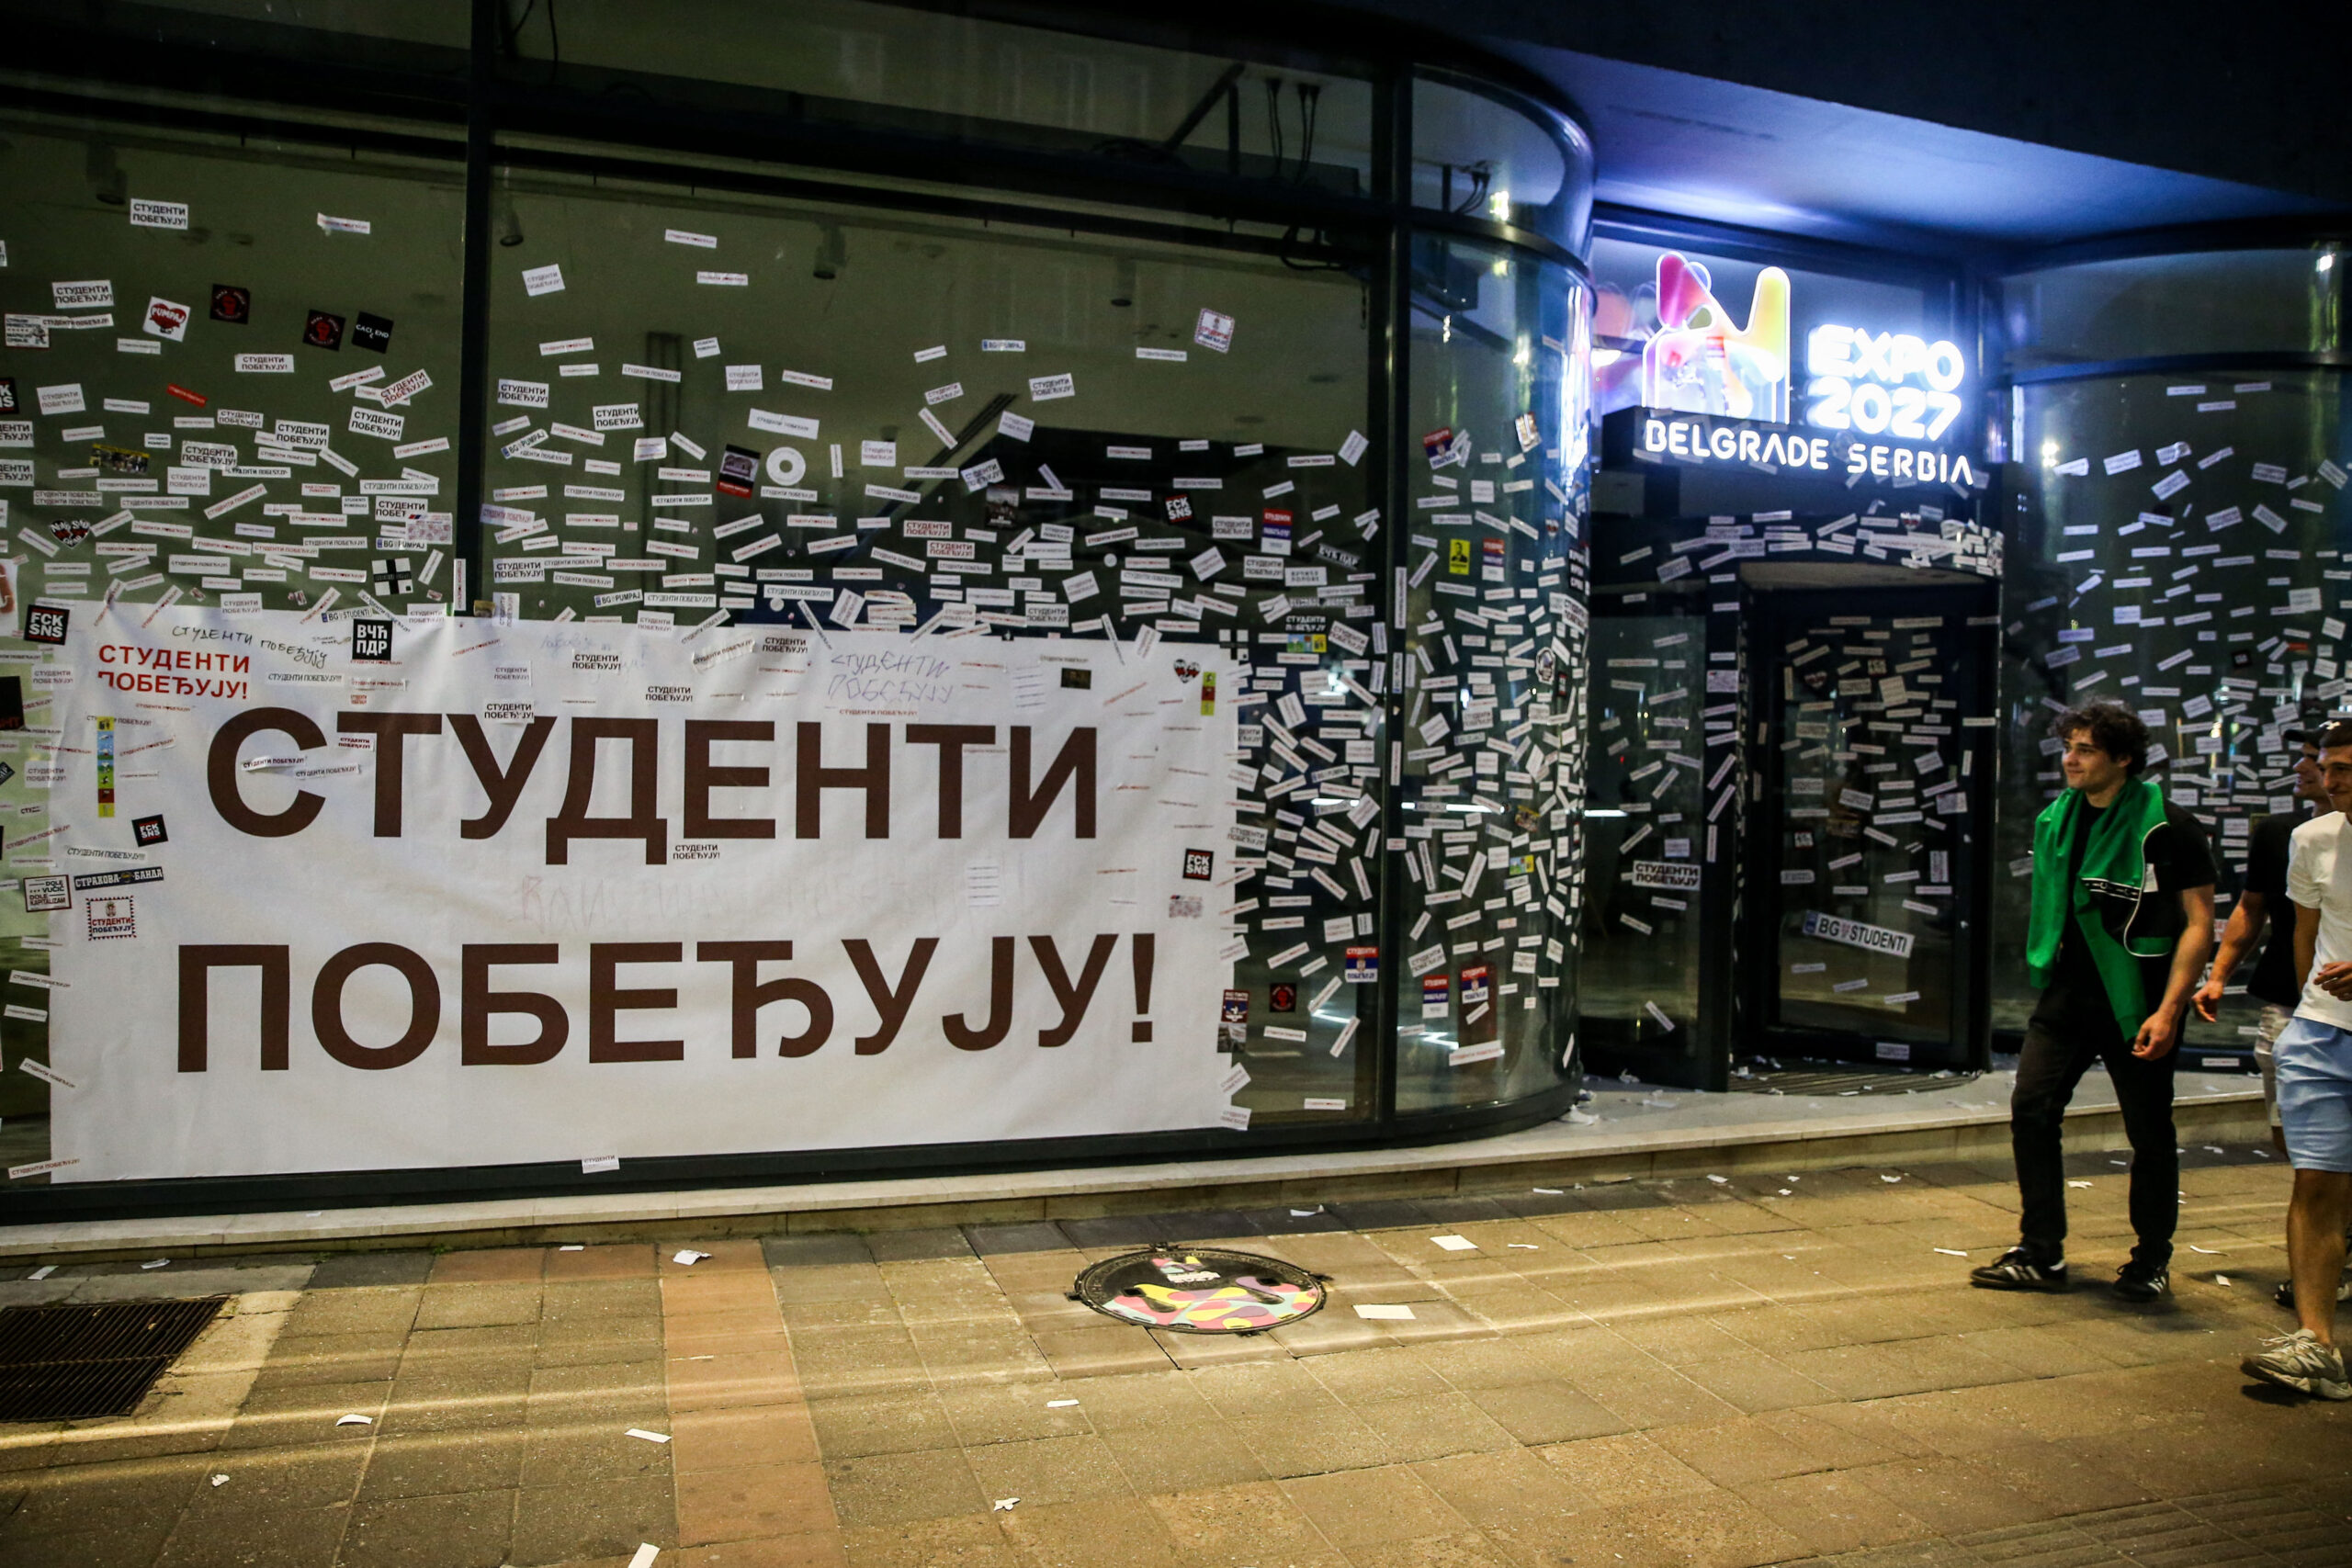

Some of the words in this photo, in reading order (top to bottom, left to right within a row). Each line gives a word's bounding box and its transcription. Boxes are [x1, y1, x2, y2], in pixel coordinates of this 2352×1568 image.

[134, 203, 186, 215] СТУДЕНТИ
[132, 214, 187, 224] ПОБЕЂУЈУ!
[56, 286, 108, 295] СТУДЕНТИ
[55, 294, 112, 303] ПОБЕЂУЈУ!
[151, 307, 184, 323] PUMPAJ
[243, 355, 285, 364] СТУДЕНТИ
[1808, 324, 1964, 392] EXPO
[501, 383, 546, 395] СТУДЕНТИ
[498, 391, 548, 403] ПОБЕЂУЈУ!
[595, 408, 639, 418] СТУДЕНТИ
[1806, 376, 1962, 442] 2027
[220, 410, 260, 420] СТУДЕНТИ
[354, 411, 401, 427] СТУДЕНТИ
[596, 417, 640, 427] ПОБЕЂУЈУ
[277, 424, 327, 435] СТУДЕНТИ
[351, 420, 401, 438] ПОБЕЂУЈУ!
[277, 434, 327, 446] ПОБЕЂУЈУ!
[185, 446, 234, 457] СТУДЕНТИ
[1645, 419, 1829, 470] BELGRADE
[1847, 443, 1973, 485] SERBIA
[379, 501, 425, 511] СТУДЕНТИ
[1166, 497, 1189, 511] FCK
[1169, 507, 1193, 520] SNS
[929, 549, 973, 558] ПОБЕЂУЈУ!
[496, 561, 541, 570] СТУДЕНТИ
[494, 570, 544, 579] ПОБЕЂУЈУ!
[601, 596, 611, 604] BG
[615, 592, 640, 602] PUMPAJ
[329, 613, 339, 621] BG
[343, 610, 369, 619] STUDENTI
[1028, 607, 1067, 615] СТУДЕНТИ
[30, 613, 63, 626] FCK
[28, 626, 63, 638] SNS
[356, 624, 388, 639] ВЧЋ
[765, 637, 807, 646] СТУДЕНТИ
[356, 639, 387, 656] ПДР
[762, 645, 808, 654] ПОБЕЂУЈУ!
[99, 645, 250, 673] СТУДЕНТИ
[574, 654, 619, 662] СТУДЕНТИ
[571, 661, 621, 671] ПОБЕЂУЈУ!
[97, 671, 248, 699] ПОБЕЂУЈУ!
[645, 694, 693, 703] ПОБЕЂУЈУ!
[486, 703, 532, 711] СТУДЕНТИ
[484, 711, 534, 719] ПОБЕЂУЈУ!
[208, 707, 1096, 864] СТУДЕНТИ
[140, 822, 159, 832] FCK
[141, 829, 160, 839] SNS
[673, 852, 720, 860] ПОБЕЂУЈУ!
[1187, 854, 1210, 865] FCK
[134, 868, 163, 880] БАНДА
[1186, 865, 1209, 875] SNS
[1634, 863, 1699, 876] СТУДЕНТИ
[1635, 874, 1698, 888] ПОБЕЂУЈУ
[92, 917, 131, 926] СТУДЕНТИ
[92, 925, 131, 933] ПОБЕЂУЈУ
[1818, 919, 1839, 937] BG
[1849, 927, 1908, 953] STUDENTI
[178, 933, 1154, 1072] ПОБЕЂУЈУ!
